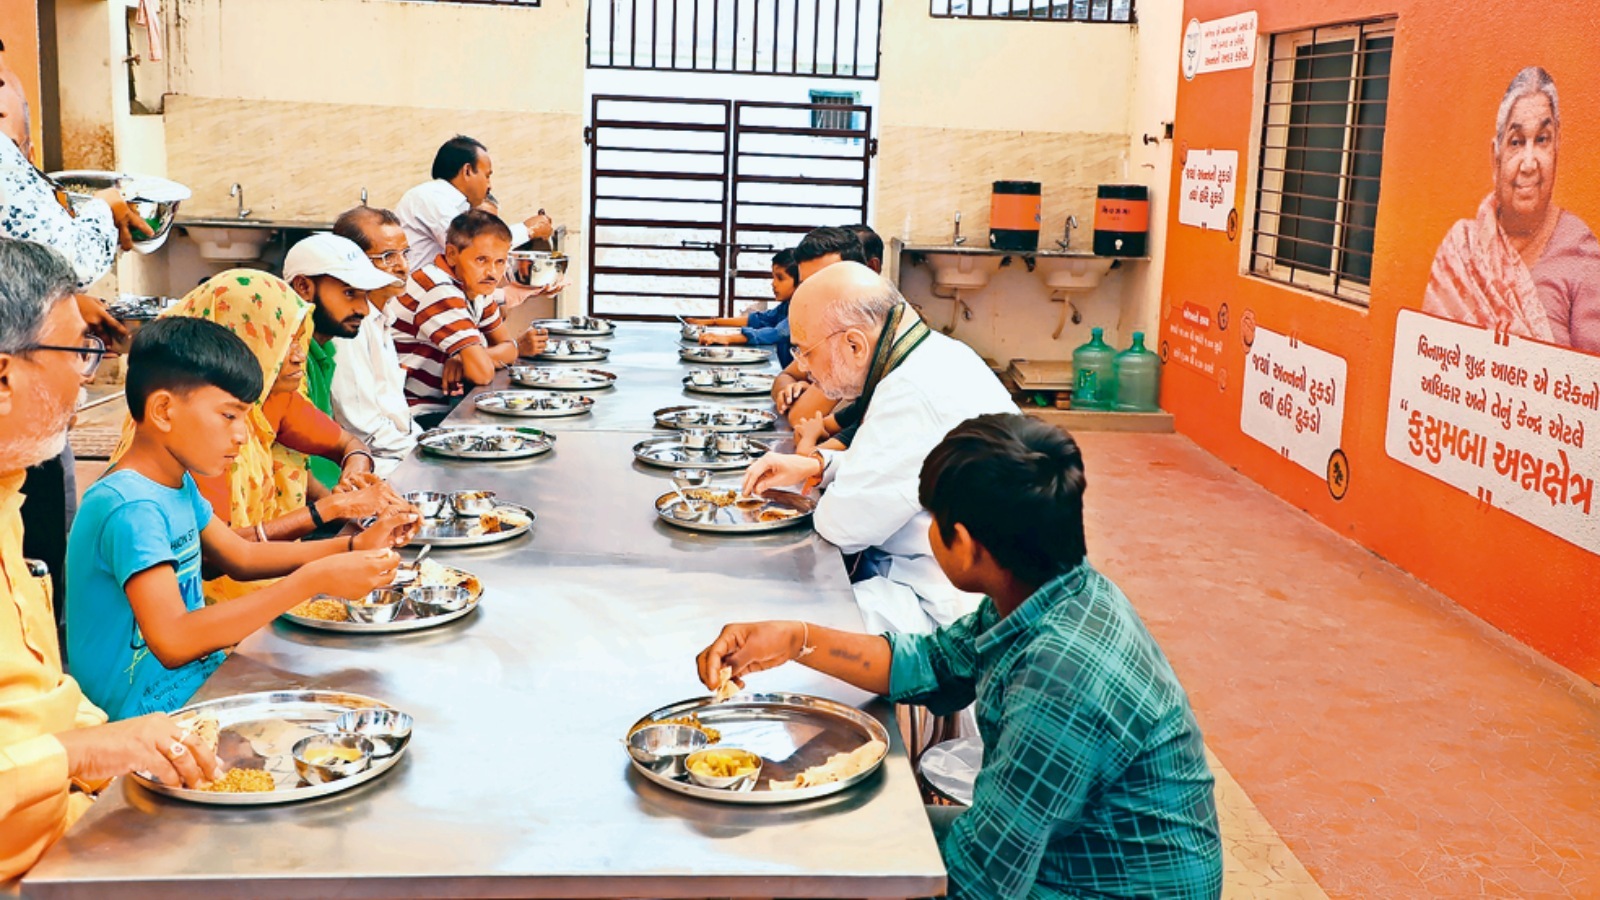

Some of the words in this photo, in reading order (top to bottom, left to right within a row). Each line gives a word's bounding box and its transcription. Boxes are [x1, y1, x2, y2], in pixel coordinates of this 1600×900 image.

[1308, 378, 1335, 406] ટુકડો
[1417, 334, 1461, 372] વિનામૂલ્યે
[1491, 361, 1528, 388] આહાર
[1533, 367, 1549, 395] એ
[1553, 374, 1599, 411] દરેકનો
[1277, 393, 1293, 419] હરિ
[1295, 407, 1320, 433] ટુકડો
[1421, 373, 1461, 405] અધિકાર
[1465, 387, 1487, 413] અને
[1490, 392, 1513, 431] તેનું
[1516, 400, 1543, 436] કેન્દ્ર
[1548, 413, 1585, 449] એટલે
